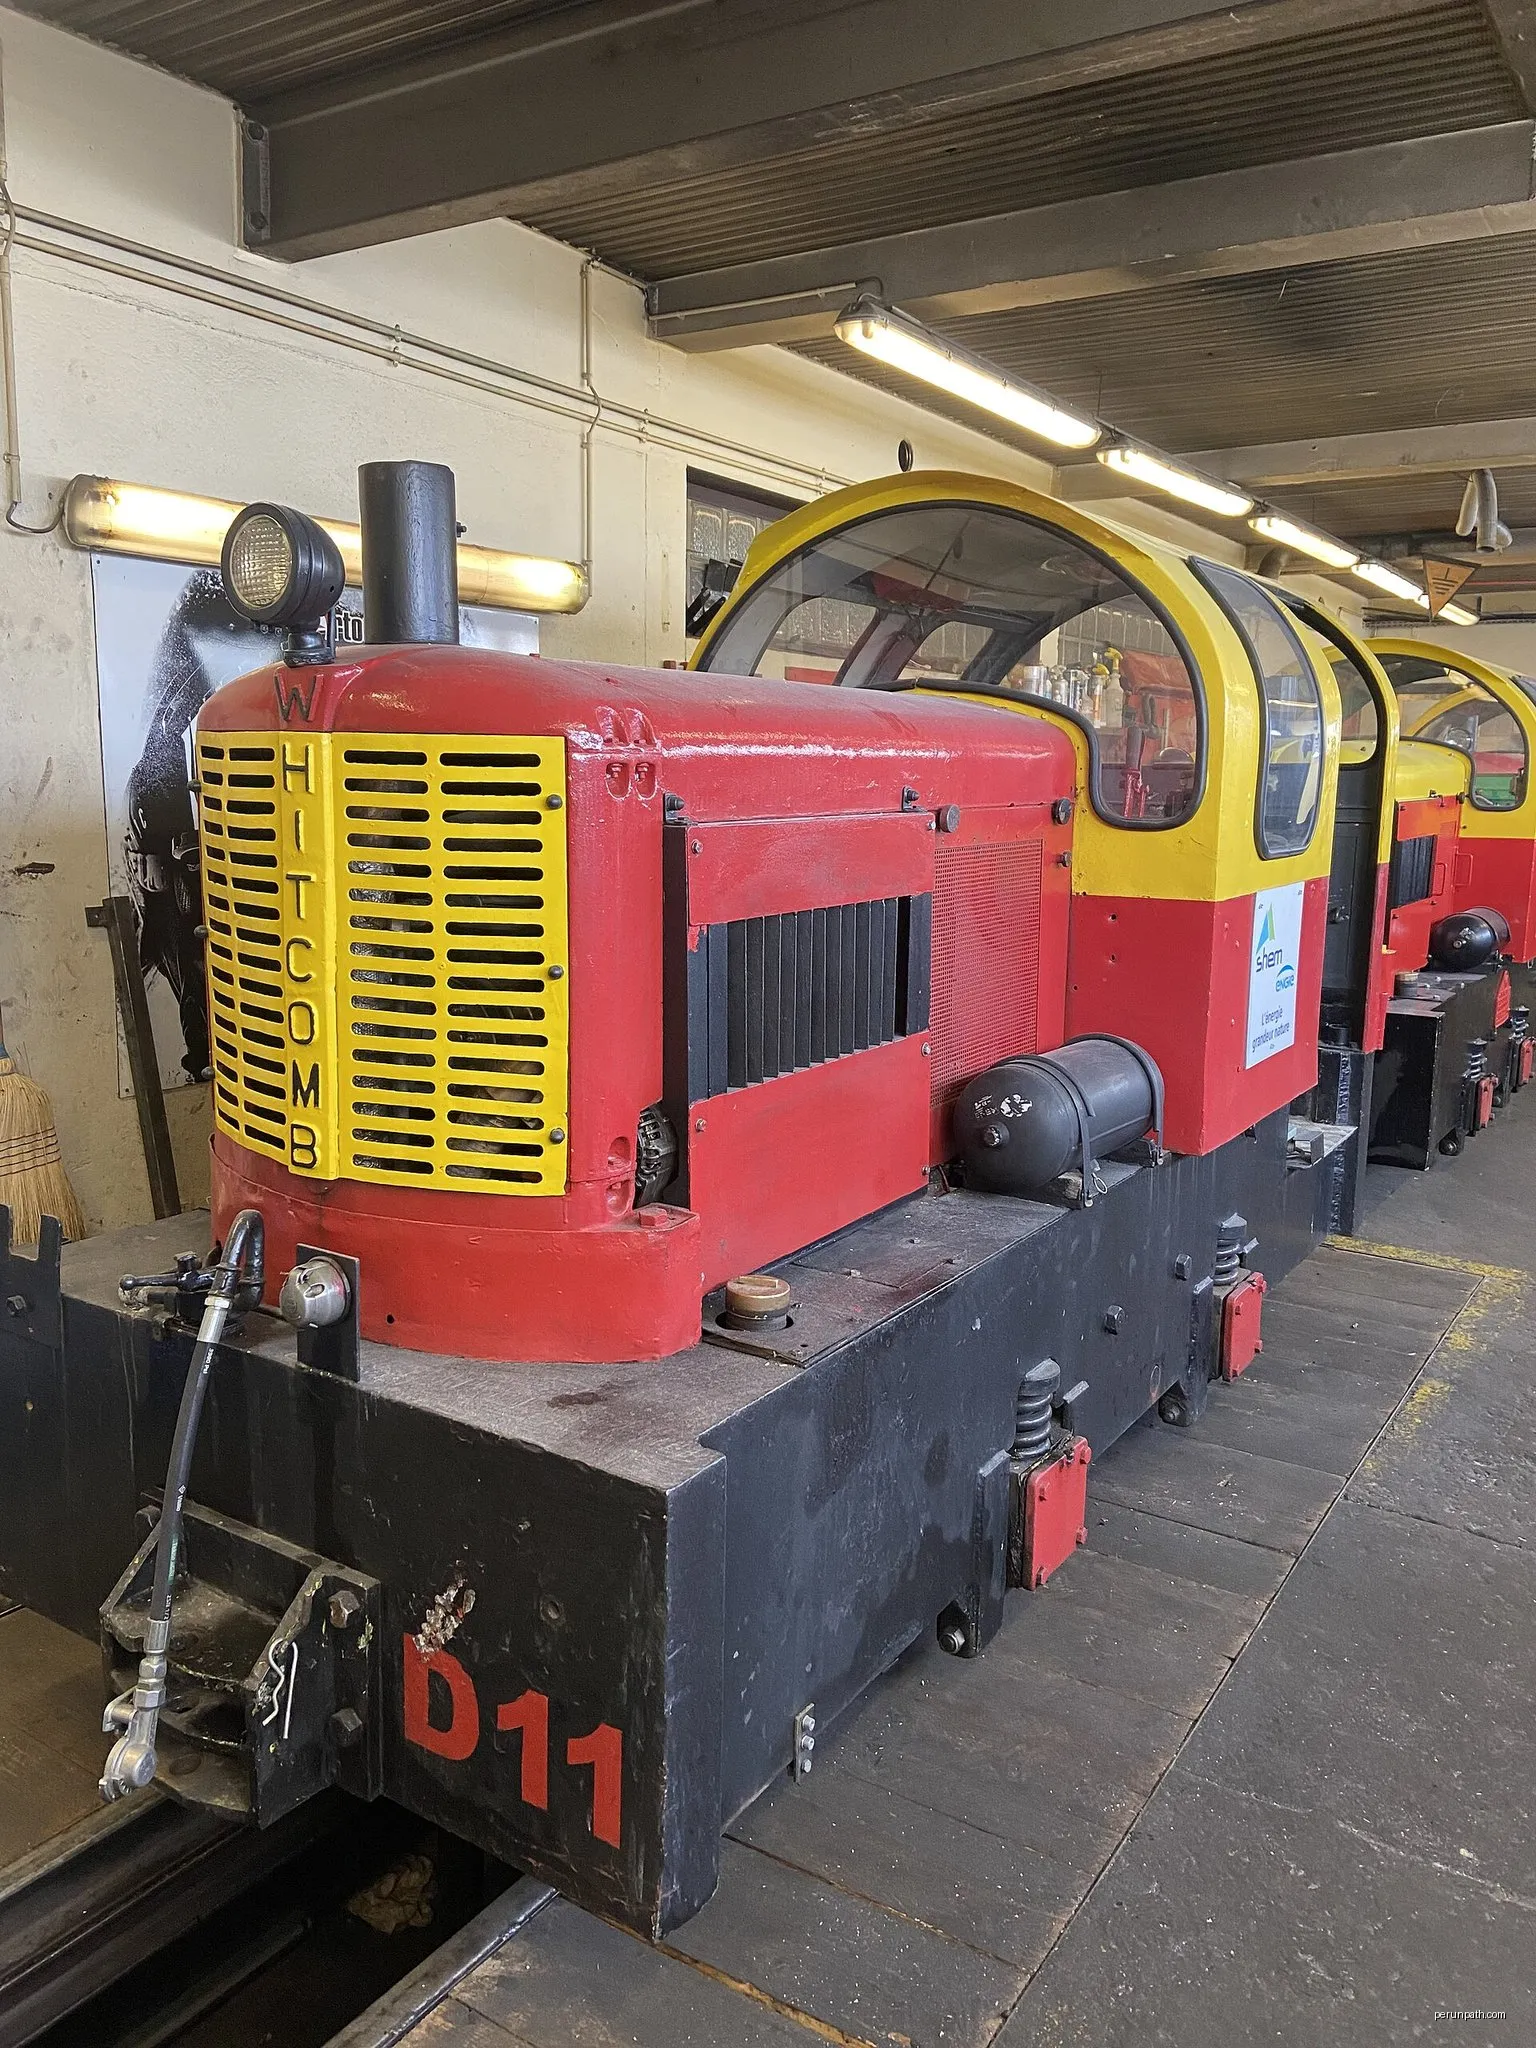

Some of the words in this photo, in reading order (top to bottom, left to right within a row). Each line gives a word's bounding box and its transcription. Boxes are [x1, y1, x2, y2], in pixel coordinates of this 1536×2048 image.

[274, 673, 325, 1169] WHITCOMB
[1255, 946, 1283, 973] shem
[1251, 1029, 1274, 1053] grandeur
[1274, 1022, 1290, 1038] nature
[403, 1632, 623, 1850] D11
